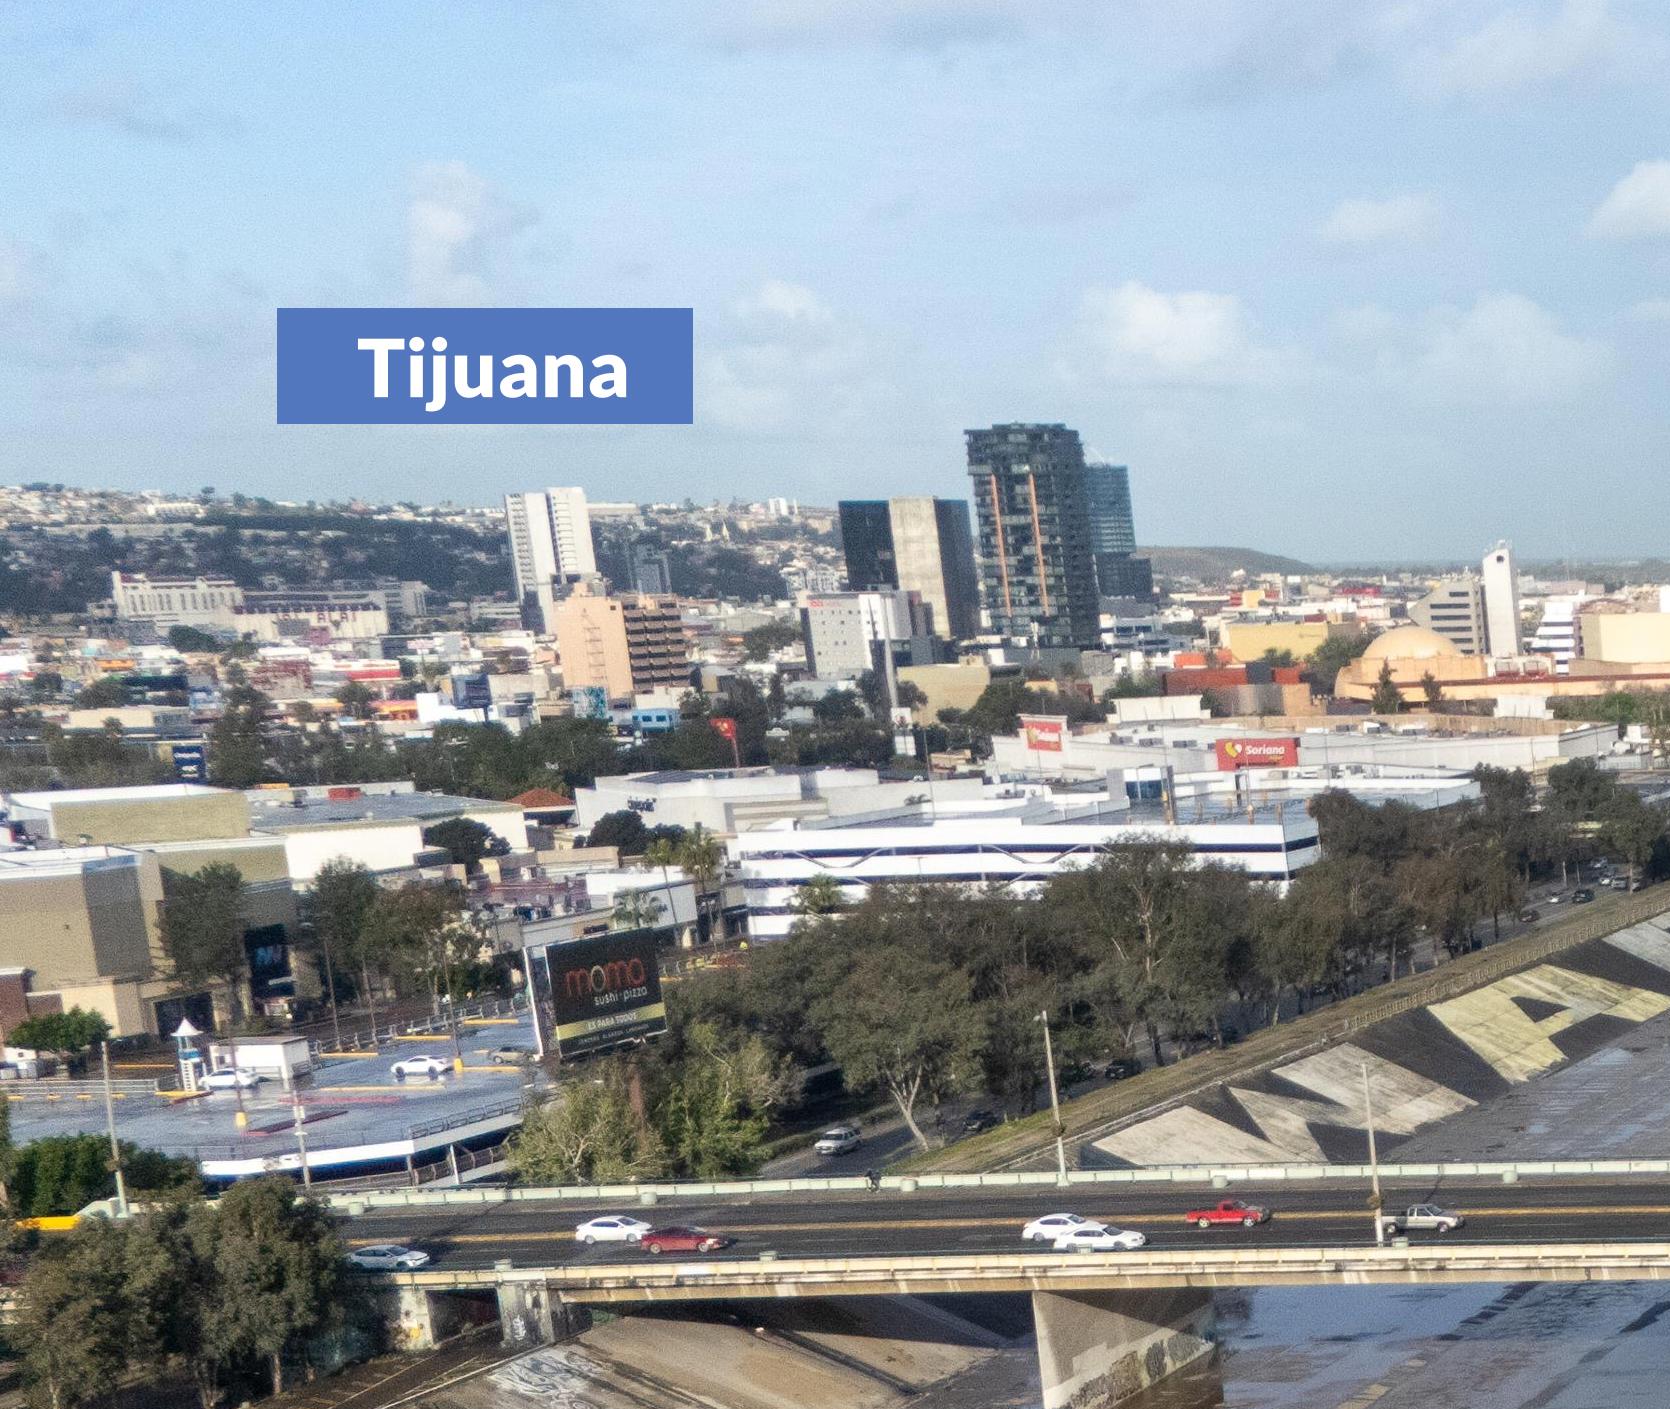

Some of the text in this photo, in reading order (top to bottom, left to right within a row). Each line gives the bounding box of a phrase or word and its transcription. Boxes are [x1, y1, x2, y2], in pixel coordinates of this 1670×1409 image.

[1244, 743, 1286, 757] Soriana
[563, 957, 647, 998] momo
[593, 986, 648, 1007] sushi pizza
